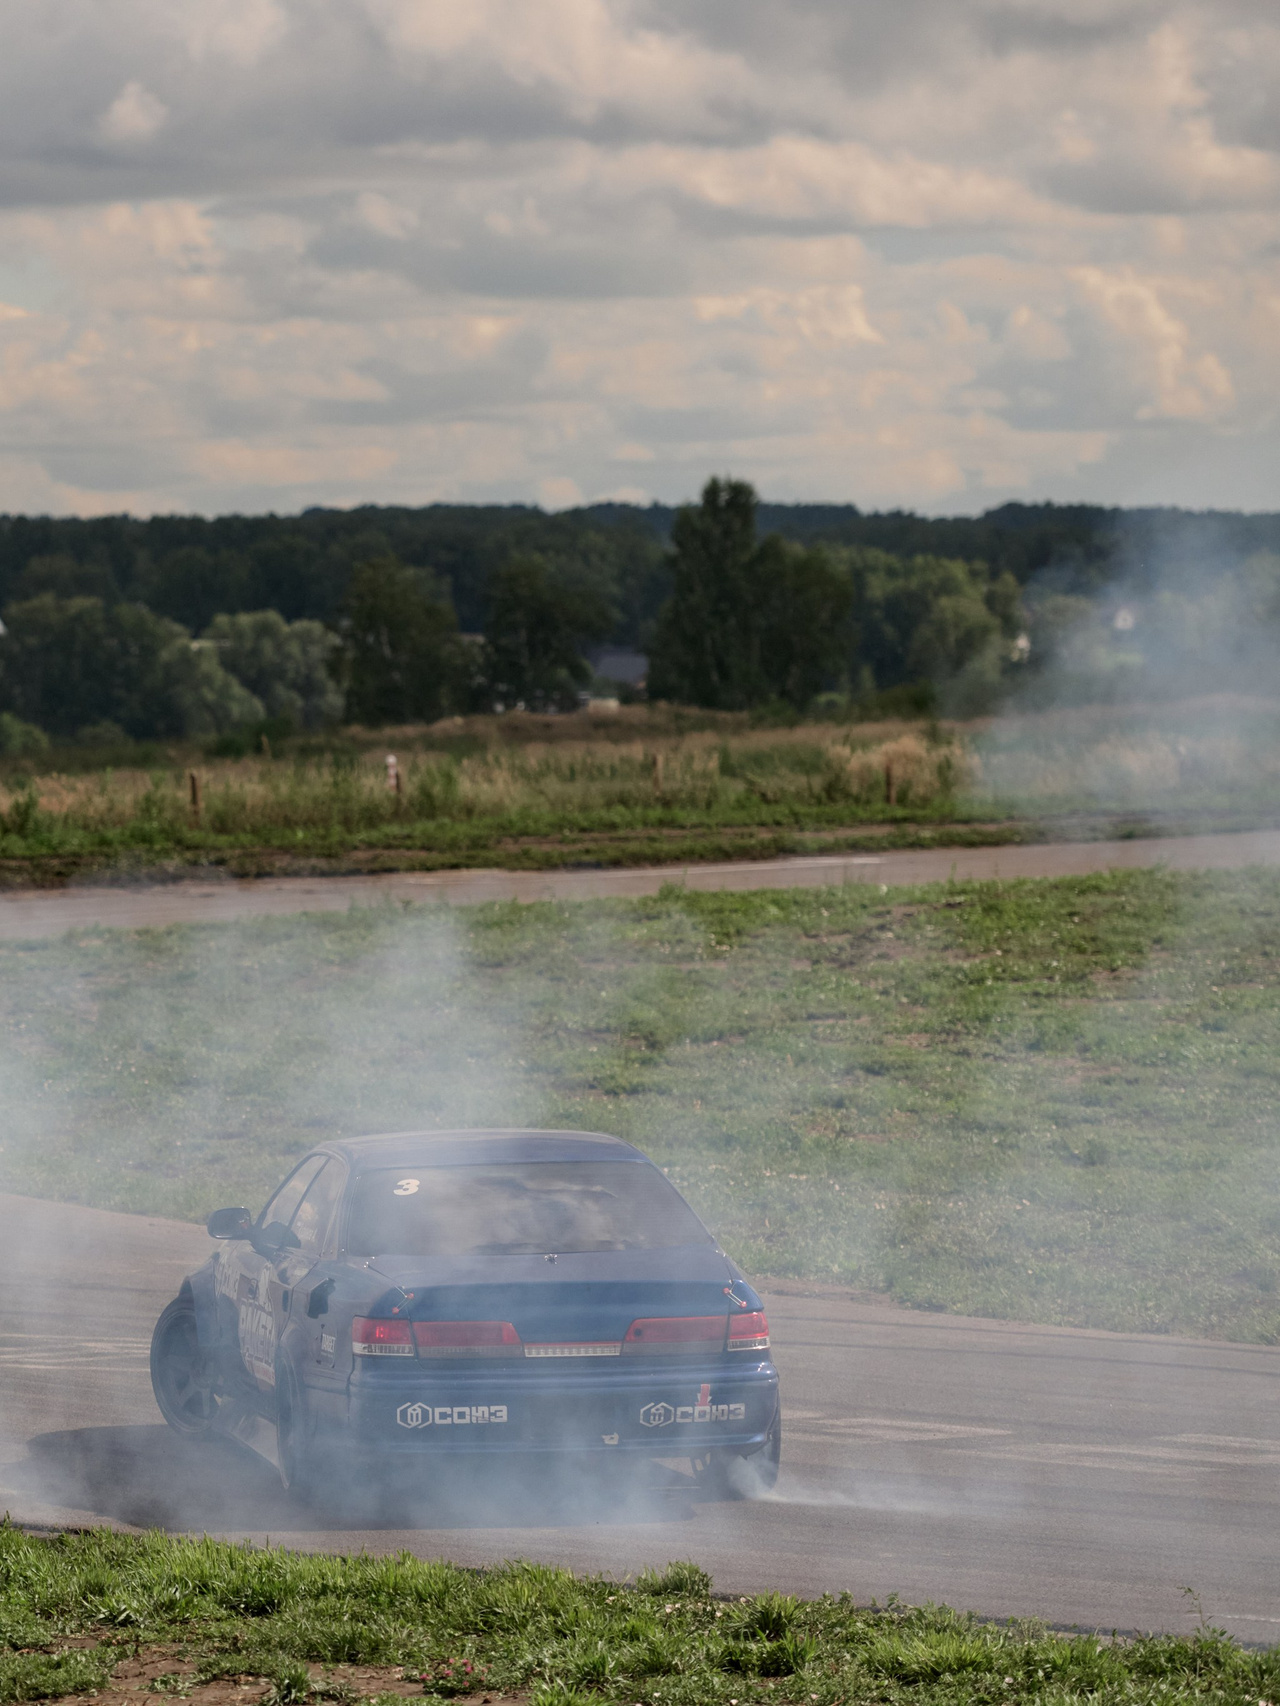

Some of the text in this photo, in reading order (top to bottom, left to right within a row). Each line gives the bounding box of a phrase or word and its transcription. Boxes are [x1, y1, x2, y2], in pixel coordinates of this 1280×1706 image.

[393, 1178, 420, 1196] 3
[434, 1405, 508, 1424] СОЮЗ
[676, 1403, 745, 1423] СОЮЗ
